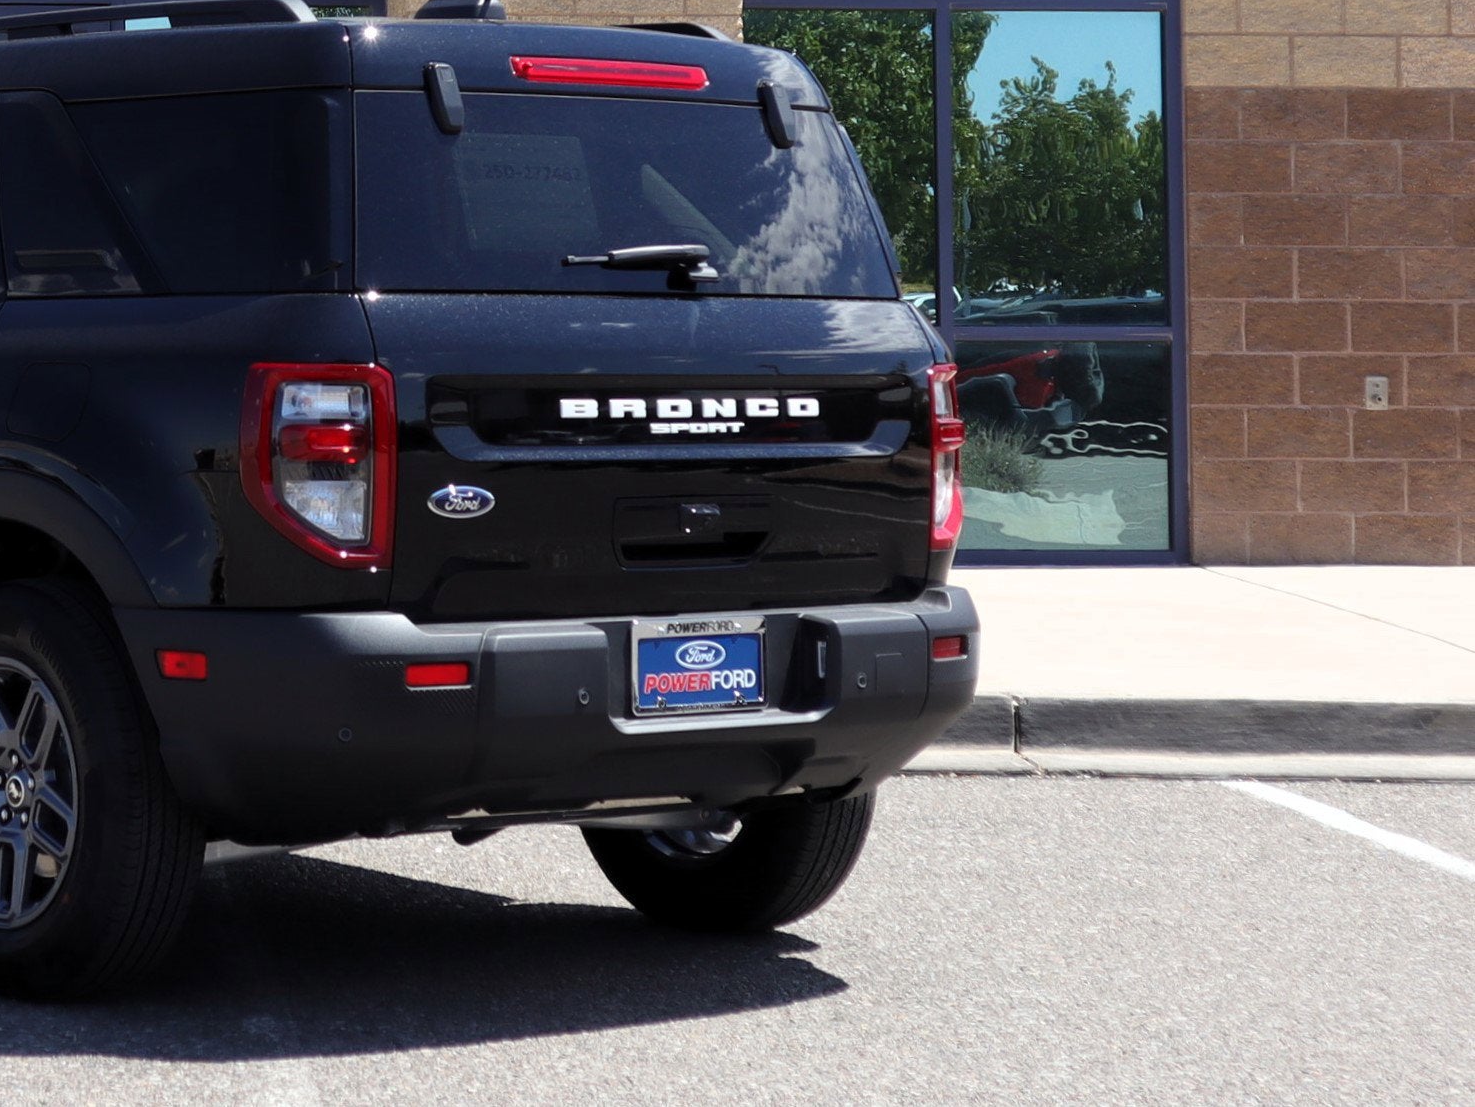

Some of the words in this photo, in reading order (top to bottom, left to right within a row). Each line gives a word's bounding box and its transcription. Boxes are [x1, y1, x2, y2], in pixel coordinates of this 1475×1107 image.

[560, 397, 821, 419] BRONCO
[650, 422, 745, 434] SPORT
[444, 492, 481, 511] Ford
[685, 646, 716, 663] Ford
[644, 668, 757, 694] POWERFORD
